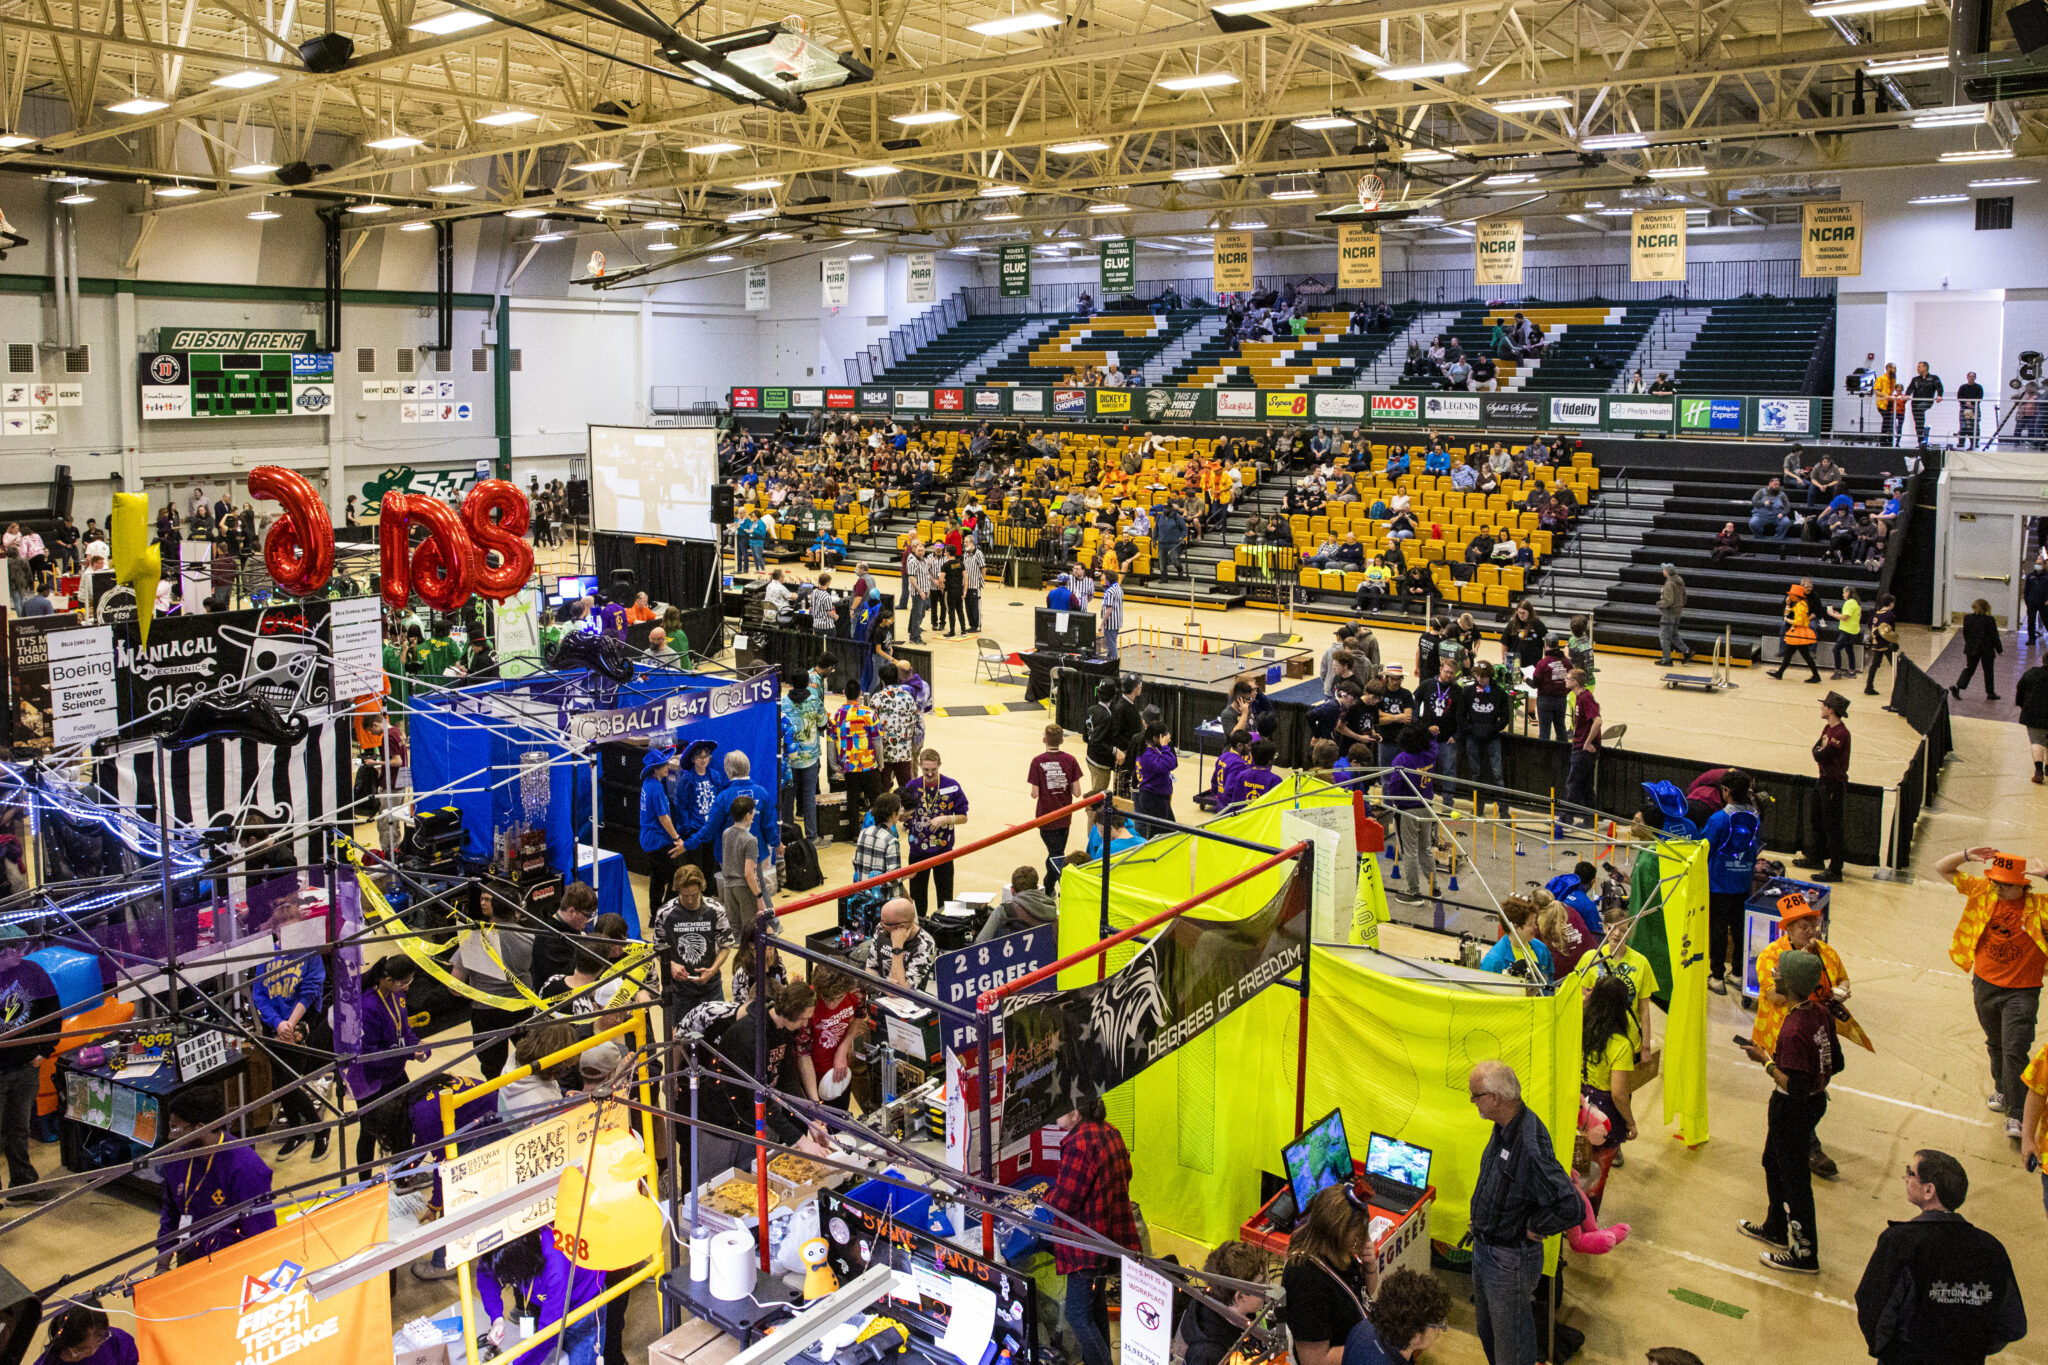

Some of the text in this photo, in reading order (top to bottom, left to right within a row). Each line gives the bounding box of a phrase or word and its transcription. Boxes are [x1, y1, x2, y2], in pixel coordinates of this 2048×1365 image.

[1814, 214, 1852, 223] VOLLEYBALL
[1482, 229, 1515, 237] BASKETBALL
[1640, 222, 1677, 230] BASKETBALL
[1637, 234, 1678, 249] NCAA
[1809, 227, 1856, 242] NCAA
[1343, 246, 1376, 259] NCAA
[1480, 240, 1517, 254] NCAA
[1104, 257, 1130, 269] GLVC
[1217, 252, 1248, 264] NCAA
[911, 268, 931, 279] MIAA
[1003, 262, 1027, 274] GLVC
[749, 278, 766, 288] MIAA
[826, 273, 844, 284] MIAA
[171, 331, 307, 350] GIBSON ARENA
[296, 394, 332, 407] GLVC
[1056, 391, 1075, 402] PRICE
[1100, 394, 1128, 404] DICKEY'S
[1174, 392, 1200, 400] THIS IS
[1372, 396, 1416, 410] IMO'S
[1055, 398, 1085, 411] CHOPPER
[1171, 401, 1196, 410] MINER
[1269, 395, 1307, 415] Super 8
[1443, 400, 1479, 411] LEGENDS
[1562, 402, 1598, 419] fidelity
[1627, 407, 1671, 416] Phelps Health
[1163, 410, 1192, 418] NATION
[1712, 411, 1739, 420] Express
[17, 636, 39, 647] IT'S
[17, 645, 47, 655] THAN
[117, 636, 218, 675] MANIACAL
[18, 654, 48, 665] ROBO
[52, 660, 113, 682] Boeing
[148, 662, 208, 677] MECHANICS
[335, 678, 350, 686] Days
[63, 687, 104, 701] Brewer
[62, 696, 106, 712] Science
[577, 679, 773, 740] COBALT 6547 COLTS
[73, 723, 96, 733] Fidelity
[1992, 855, 2014, 870] 288
[1783, 895, 1806, 909] 288
[950, 960, 1038, 1003] DEGREES
[1147, 943, 1301, 1061] DEGREES OF FREEDOM
[138, 1033, 173, 1047] 5893
[184, 1031, 217, 1053] DIRECT
[196, 1056, 218, 1073] 5893
[515, 1125, 567, 1165] SPARE
[468, 1149, 500, 1170] GATEWAY
[516, 1146, 566, 1185] PARTS
[468, 1160, 490, 1175] STEM
[553, 1229, 589, 1260] 288
[1379, 1211, 1426, 1275] EGREES
[1128, 1281, 1165, 1308] WORKPLACE
[1928, 1289, 1993, 1300] PATTONVILLE
[236, 1288, 309, 1341] FIRST
[236, 1316, 339, 1365] ALLENGE
[241, 1313, 301, 1355] TECH
